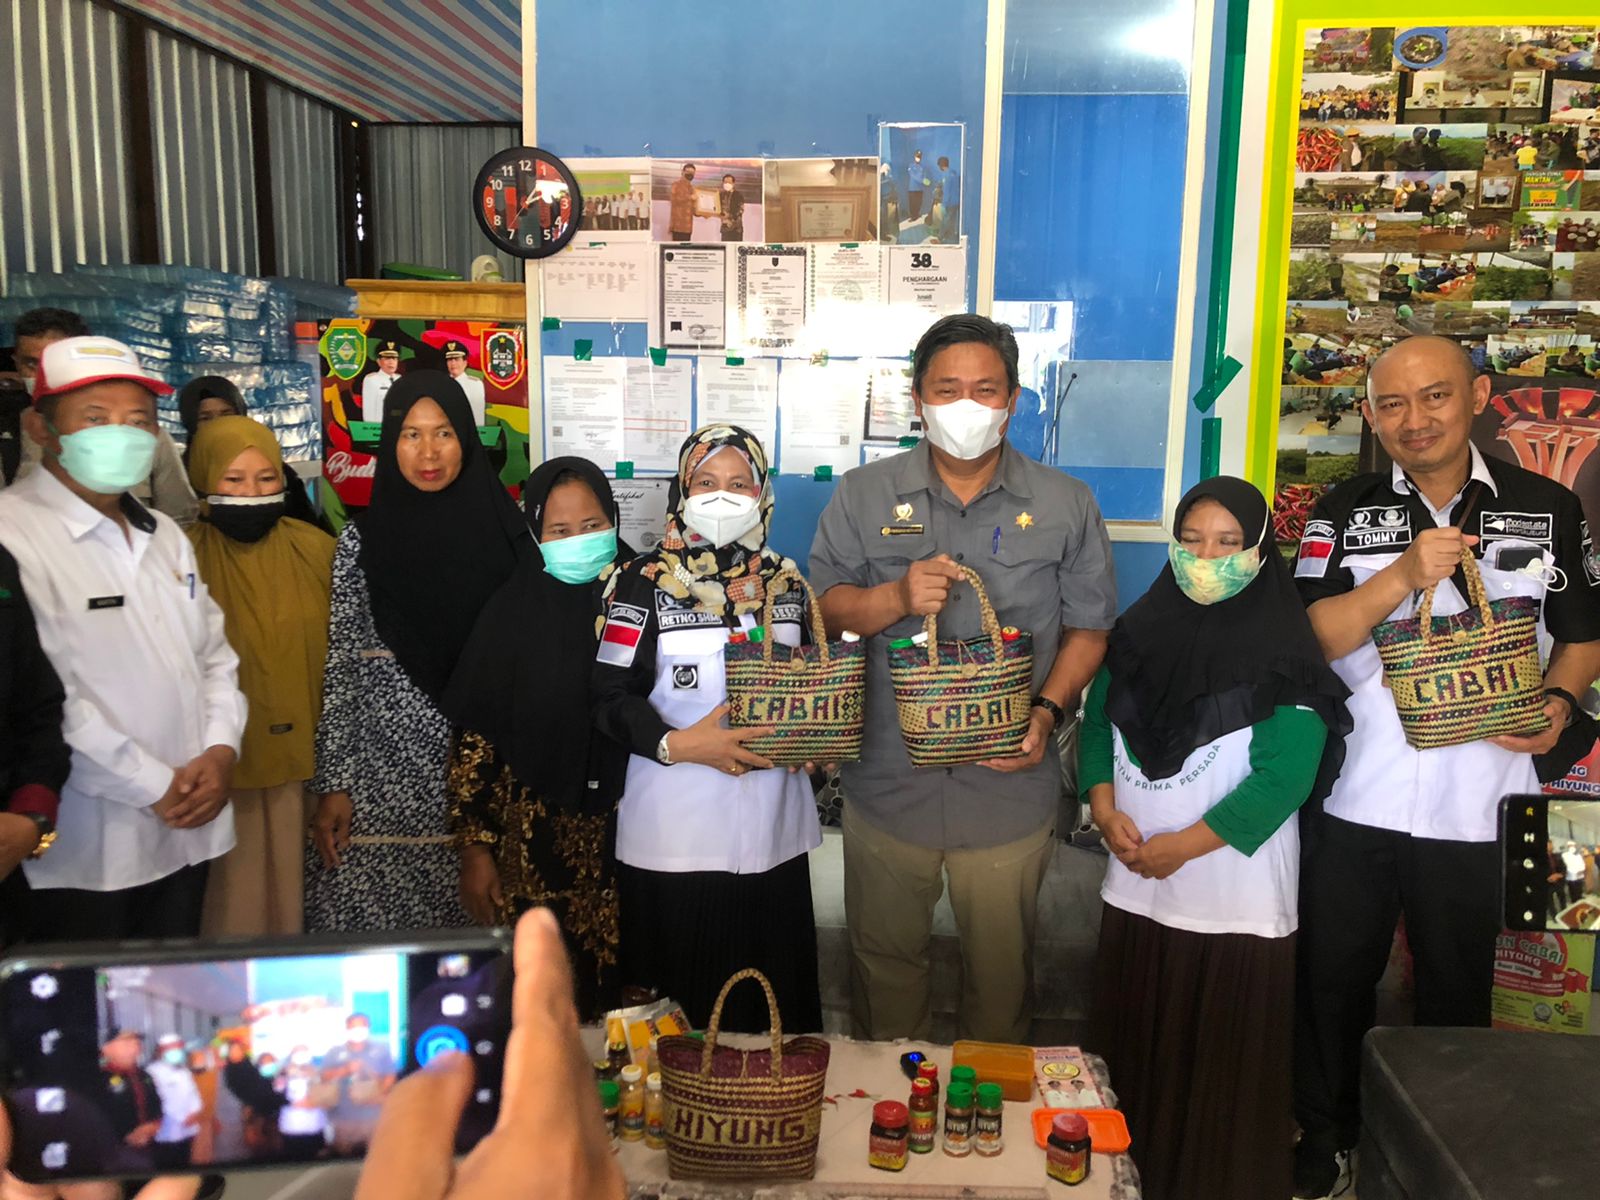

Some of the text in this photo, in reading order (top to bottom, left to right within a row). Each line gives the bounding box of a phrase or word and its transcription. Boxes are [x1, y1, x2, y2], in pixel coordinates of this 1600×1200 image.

[501, 165, 514, 176] 11
[518, 160, 532, 171] 12
[540, 165, 547, 176] 1
[490, 179, 503, 190] 10
[486, 196, 494, 208] 9
[561, 197, 569, 209] 3
[493, 215, 501, 226] 8
[554, 216, 563, 228] 4
[507, 228, 515, 240] 7
[525, 234, 533, 245] 6
[543, 229, 551, 240] 5
[911, 253, 932, 268] 38
[1357, 532, 1398, 546] TOMMY
[661, 614, 696, 627] RETNO
[1414, 663, 1520, 704] CABAI
[748, 696, 839, 721] CABAI
[926, 698, 1012, 729] CABAI
[1134, 780, 1173, 791] PRIMA
[1179, 744, 1221, 786] PERSADA
[1495, 949, 1541, 967] HIYUNG
[1520, 940, 1564, 965] CABAI
[674, 1108, 806, 1145] HIYUNG
